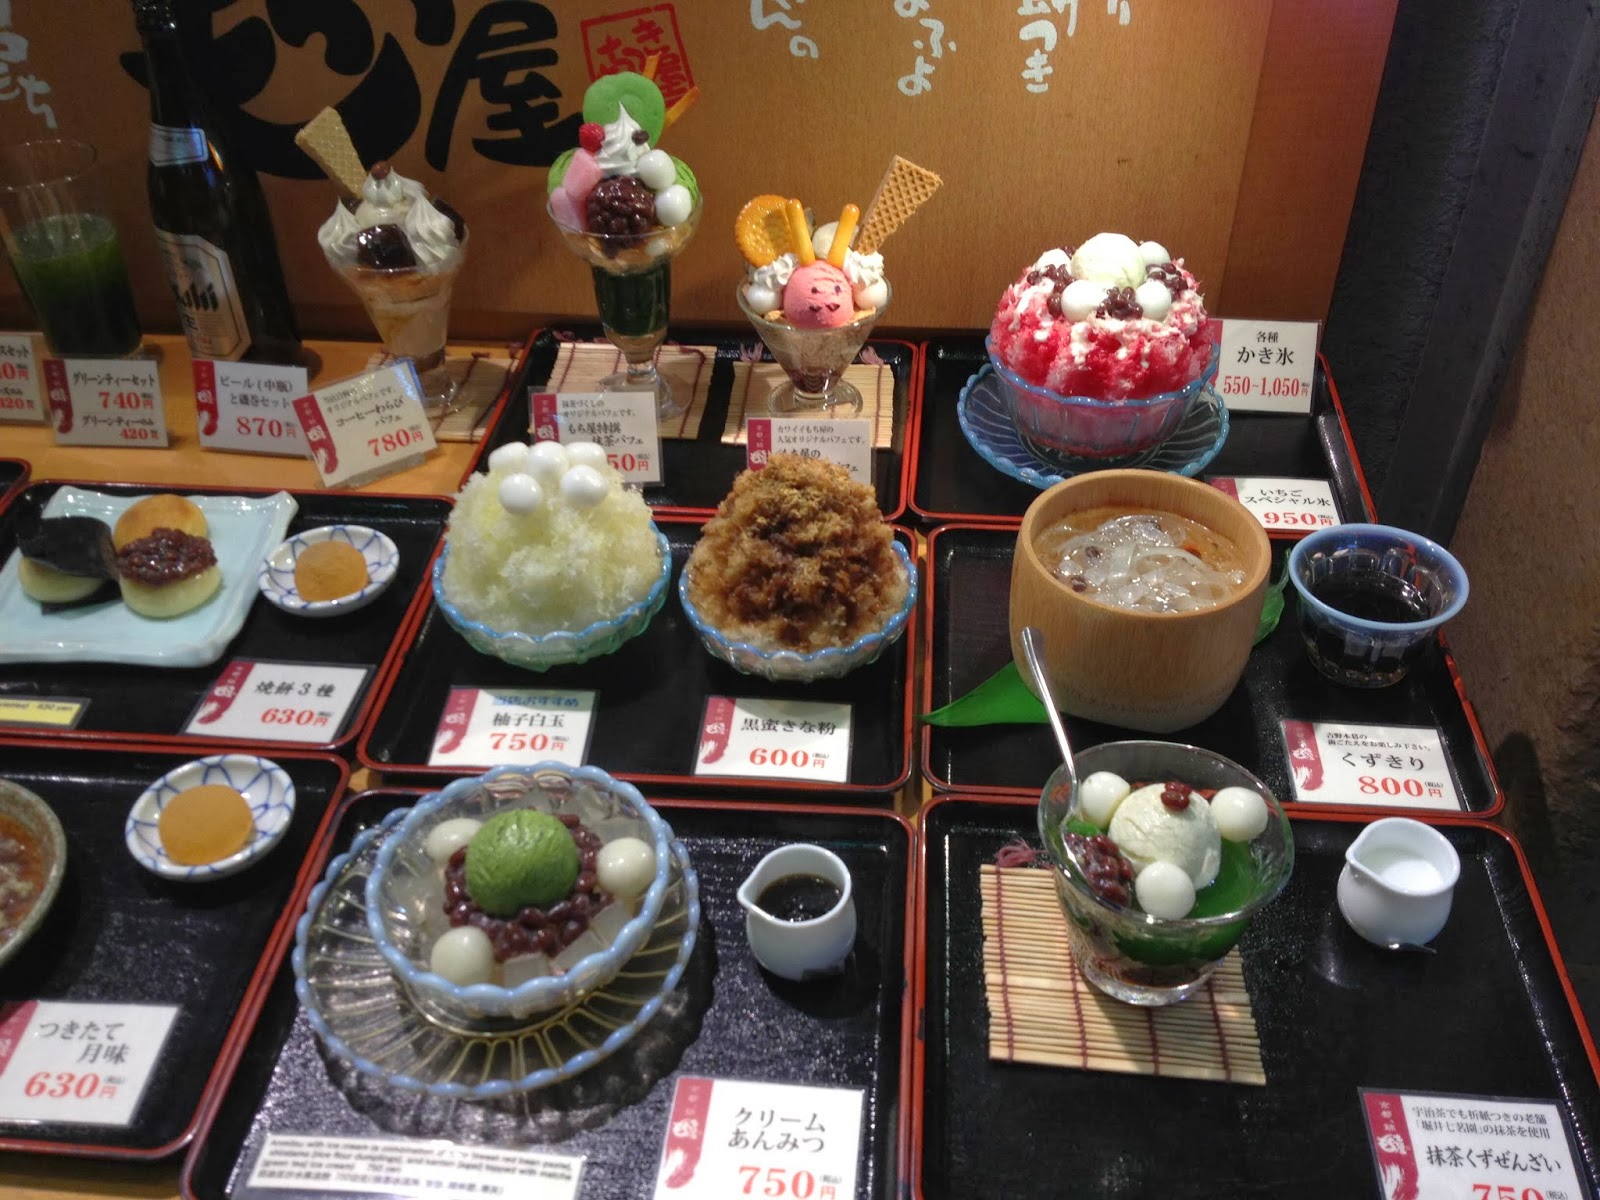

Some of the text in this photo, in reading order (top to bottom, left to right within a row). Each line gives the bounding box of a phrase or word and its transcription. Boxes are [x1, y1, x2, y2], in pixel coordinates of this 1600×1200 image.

[1256, 331, 1279, 343] 各種
[1237, 347, 1295, 365] かき氷
[1245, 496, 1331, 507] スペシャル氷
[1260, 488, 1303, 498] いちご
[493, 712, 565, 728] 柚子白玉
[741, 718, 837, 735] 黒蜜きな粉
[1342, 752, 1424, 771] くずきり
[40, 1020, 125, 1040] つきたて
[734, 1107, 826, 1132] クリーム
[728, 1128, 825, 1153] あんみつ
[1426, 1145, 1562, 1172] 抹茶くずぜんざい
